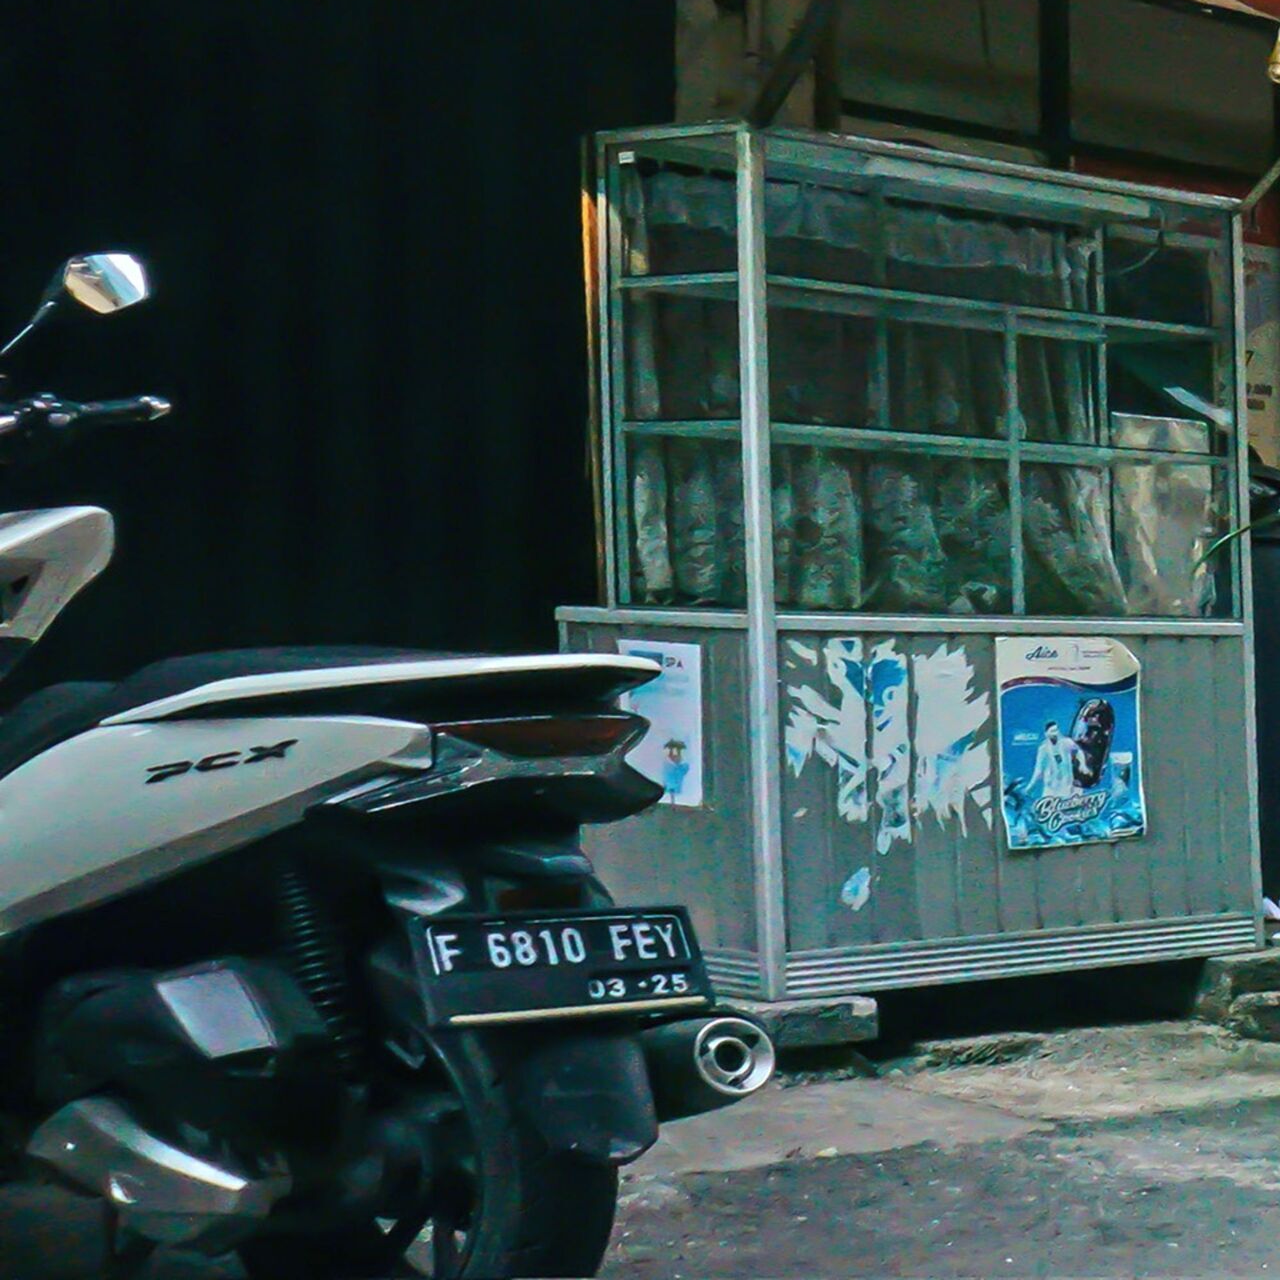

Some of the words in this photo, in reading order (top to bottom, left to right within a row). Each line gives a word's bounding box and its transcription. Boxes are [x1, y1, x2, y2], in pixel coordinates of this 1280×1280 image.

[145, 738, 299, 784] PCX
[435, 933, 462, 971] F
[487, 928, 586, 968] 6810
[609, 922, 677, 961] FEY
